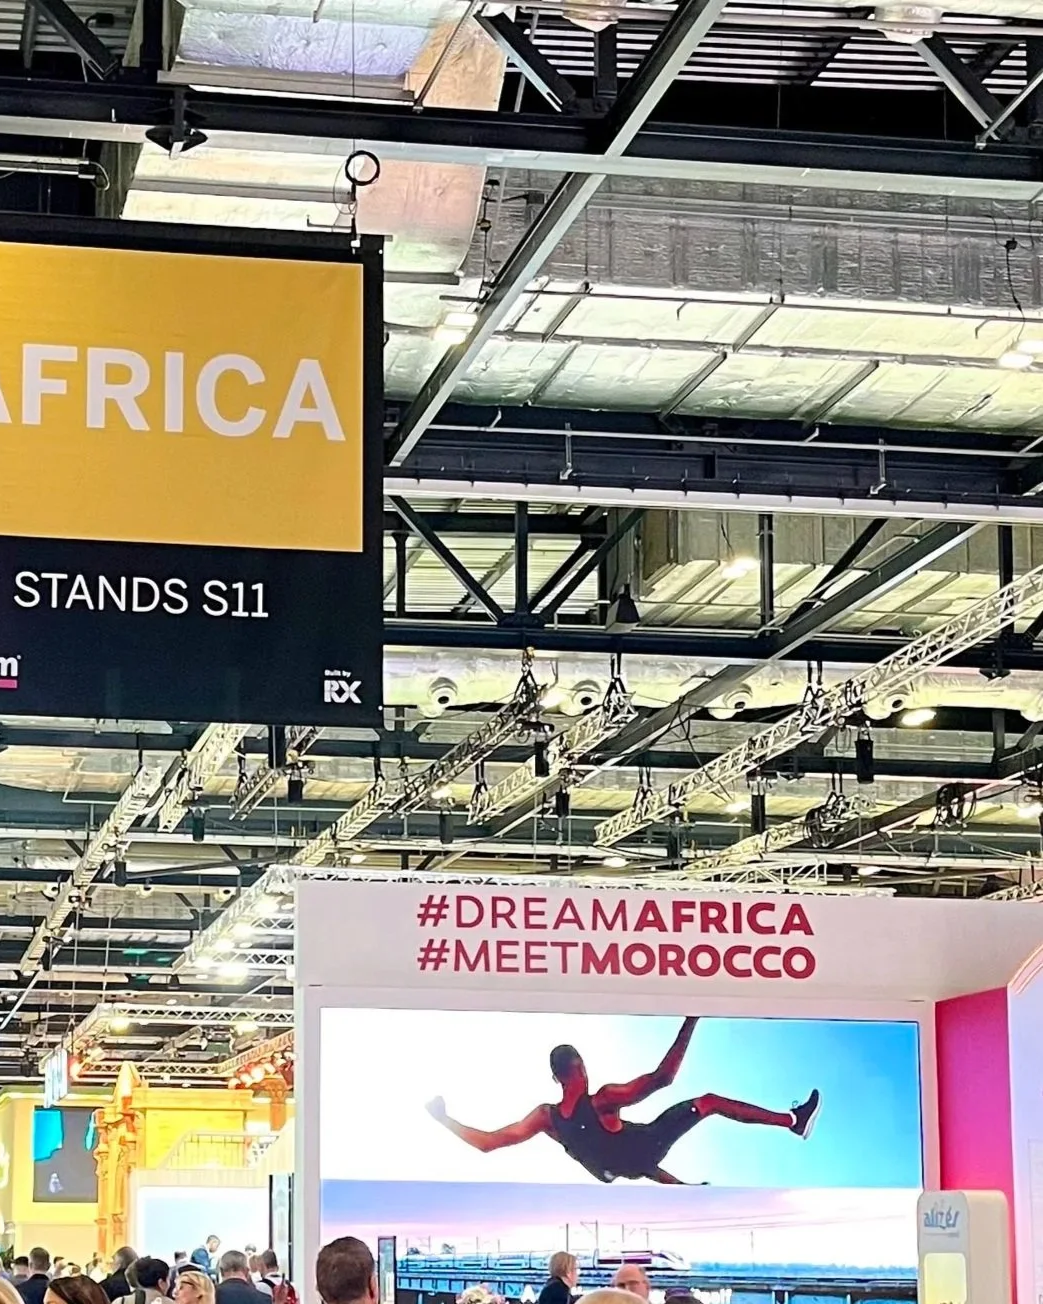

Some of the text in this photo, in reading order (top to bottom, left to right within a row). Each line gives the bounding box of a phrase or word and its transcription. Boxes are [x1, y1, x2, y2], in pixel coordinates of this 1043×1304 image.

[13, 571, 269, 617] STANDS S11
[323, 680, 362, 703] RX
[417, 894, 815, 936] #DREAMAFRICA
[417, 938, 816, 979] #MEETMOROCCO
